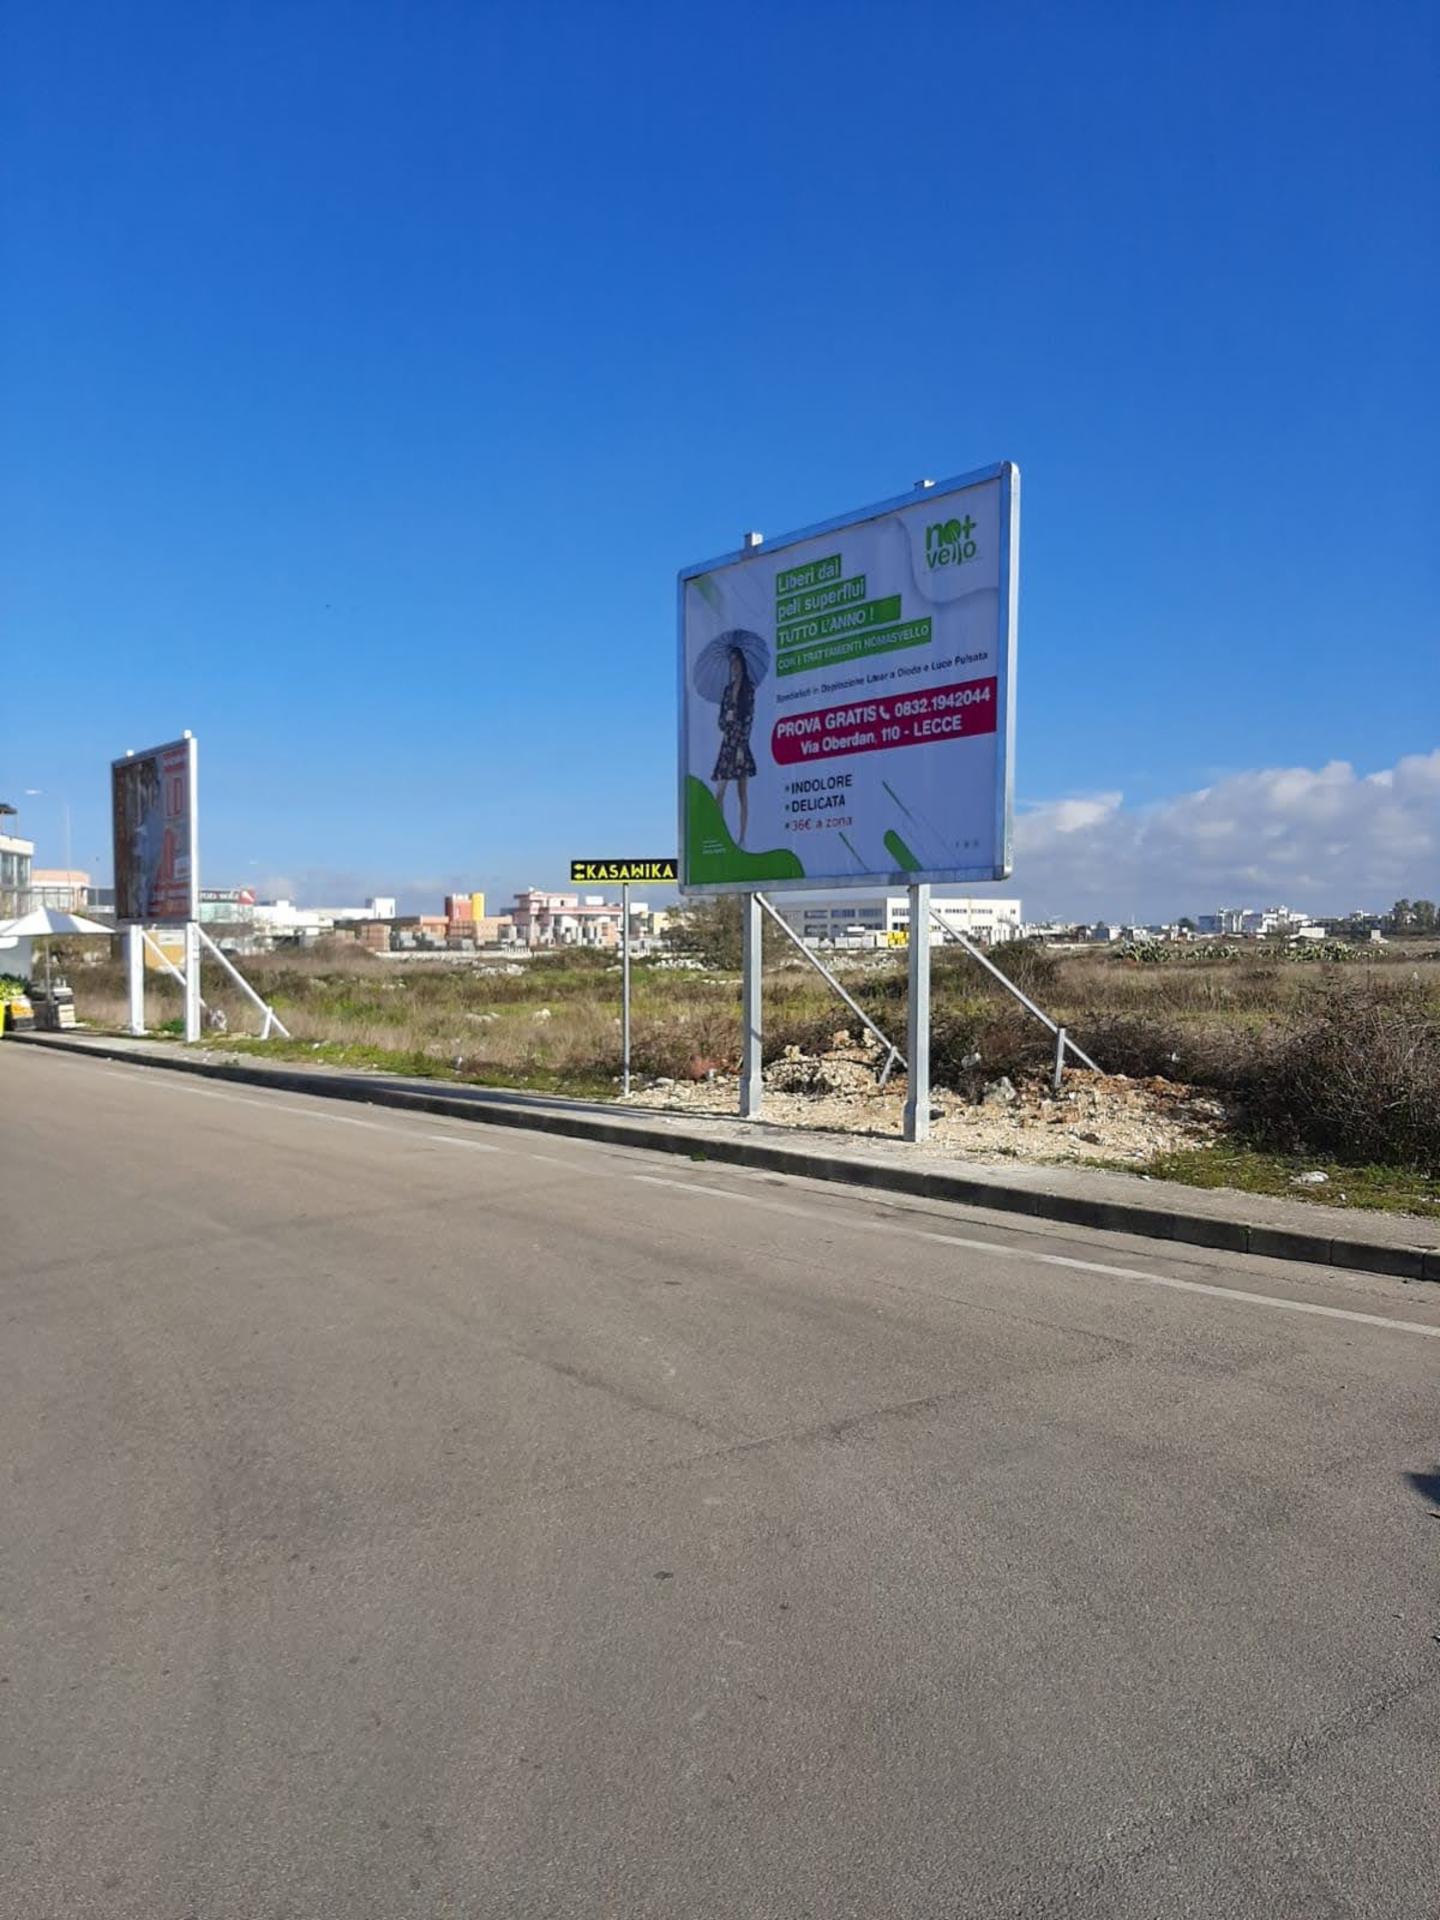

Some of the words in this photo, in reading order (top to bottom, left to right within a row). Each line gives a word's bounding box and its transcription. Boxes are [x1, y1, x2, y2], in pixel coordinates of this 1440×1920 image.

[778, 566, 815, 593] Liberi
[804, 578, 865, 611] superflui
[778, 623, 818, 645] TUTTO
[821, 610, 866, 633] L'ANNO
[803, 640, 862, 663] TRATTAMENTI
[954, 652, 988, 667] Pulsata
[777, 717, 822, 738] PROVA
[825, 705, 877, 730] GRATIS
[895, 686, 990, 717] 0832.1942044
[801, 740, 820, 755] Via
[881, 726, 901, 742] 110
[913, 714, 963, 737] LECCE
[791, 774, 853, 795] INDOLORE
[791, 794, 846, 813] DELICATA
[586, 863, 674, 879] KASAWIKA
